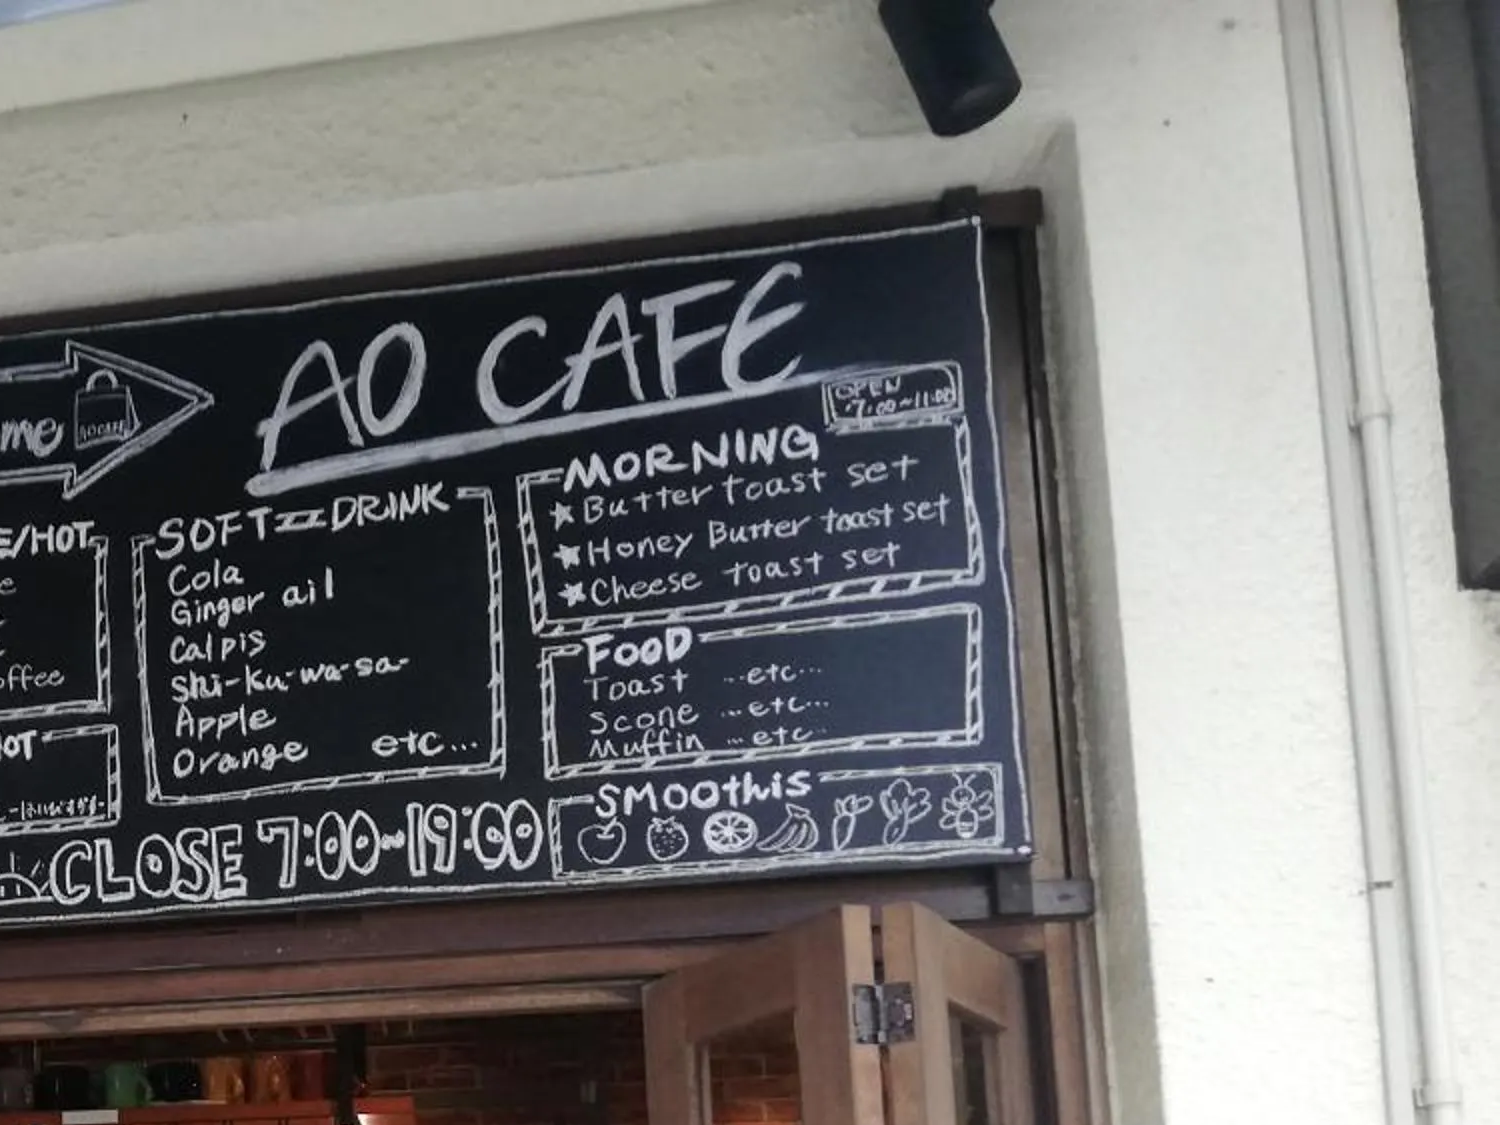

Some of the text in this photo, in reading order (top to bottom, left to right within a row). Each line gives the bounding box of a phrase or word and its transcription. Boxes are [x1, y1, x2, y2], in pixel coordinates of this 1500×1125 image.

[257, 261, 807, 471] AO CAFE
[835, 374, 901, 399] OPEN
[561, 423, 820, 493] MORNING
[582, 453, 920, 526] Butter toast set
[155, 481, 451, 560] SOFT DRINK
[587, 494, 951, 568] Honey Butter toast set
[168, 558, 245, 598] Cola
[171, 566, 335, 629] Ginger ail
[589, 540, 901, 607] Cheese toast set
[584, 667, 689, 701] Toast
[174, 704, 278, 740] Apple
[587, 728, 706, 760] Muffin
[589, 702, 700, 735] Scone
[172, 739, 310, 778] Orange
[49, 824, 248, 904] CLOSE
